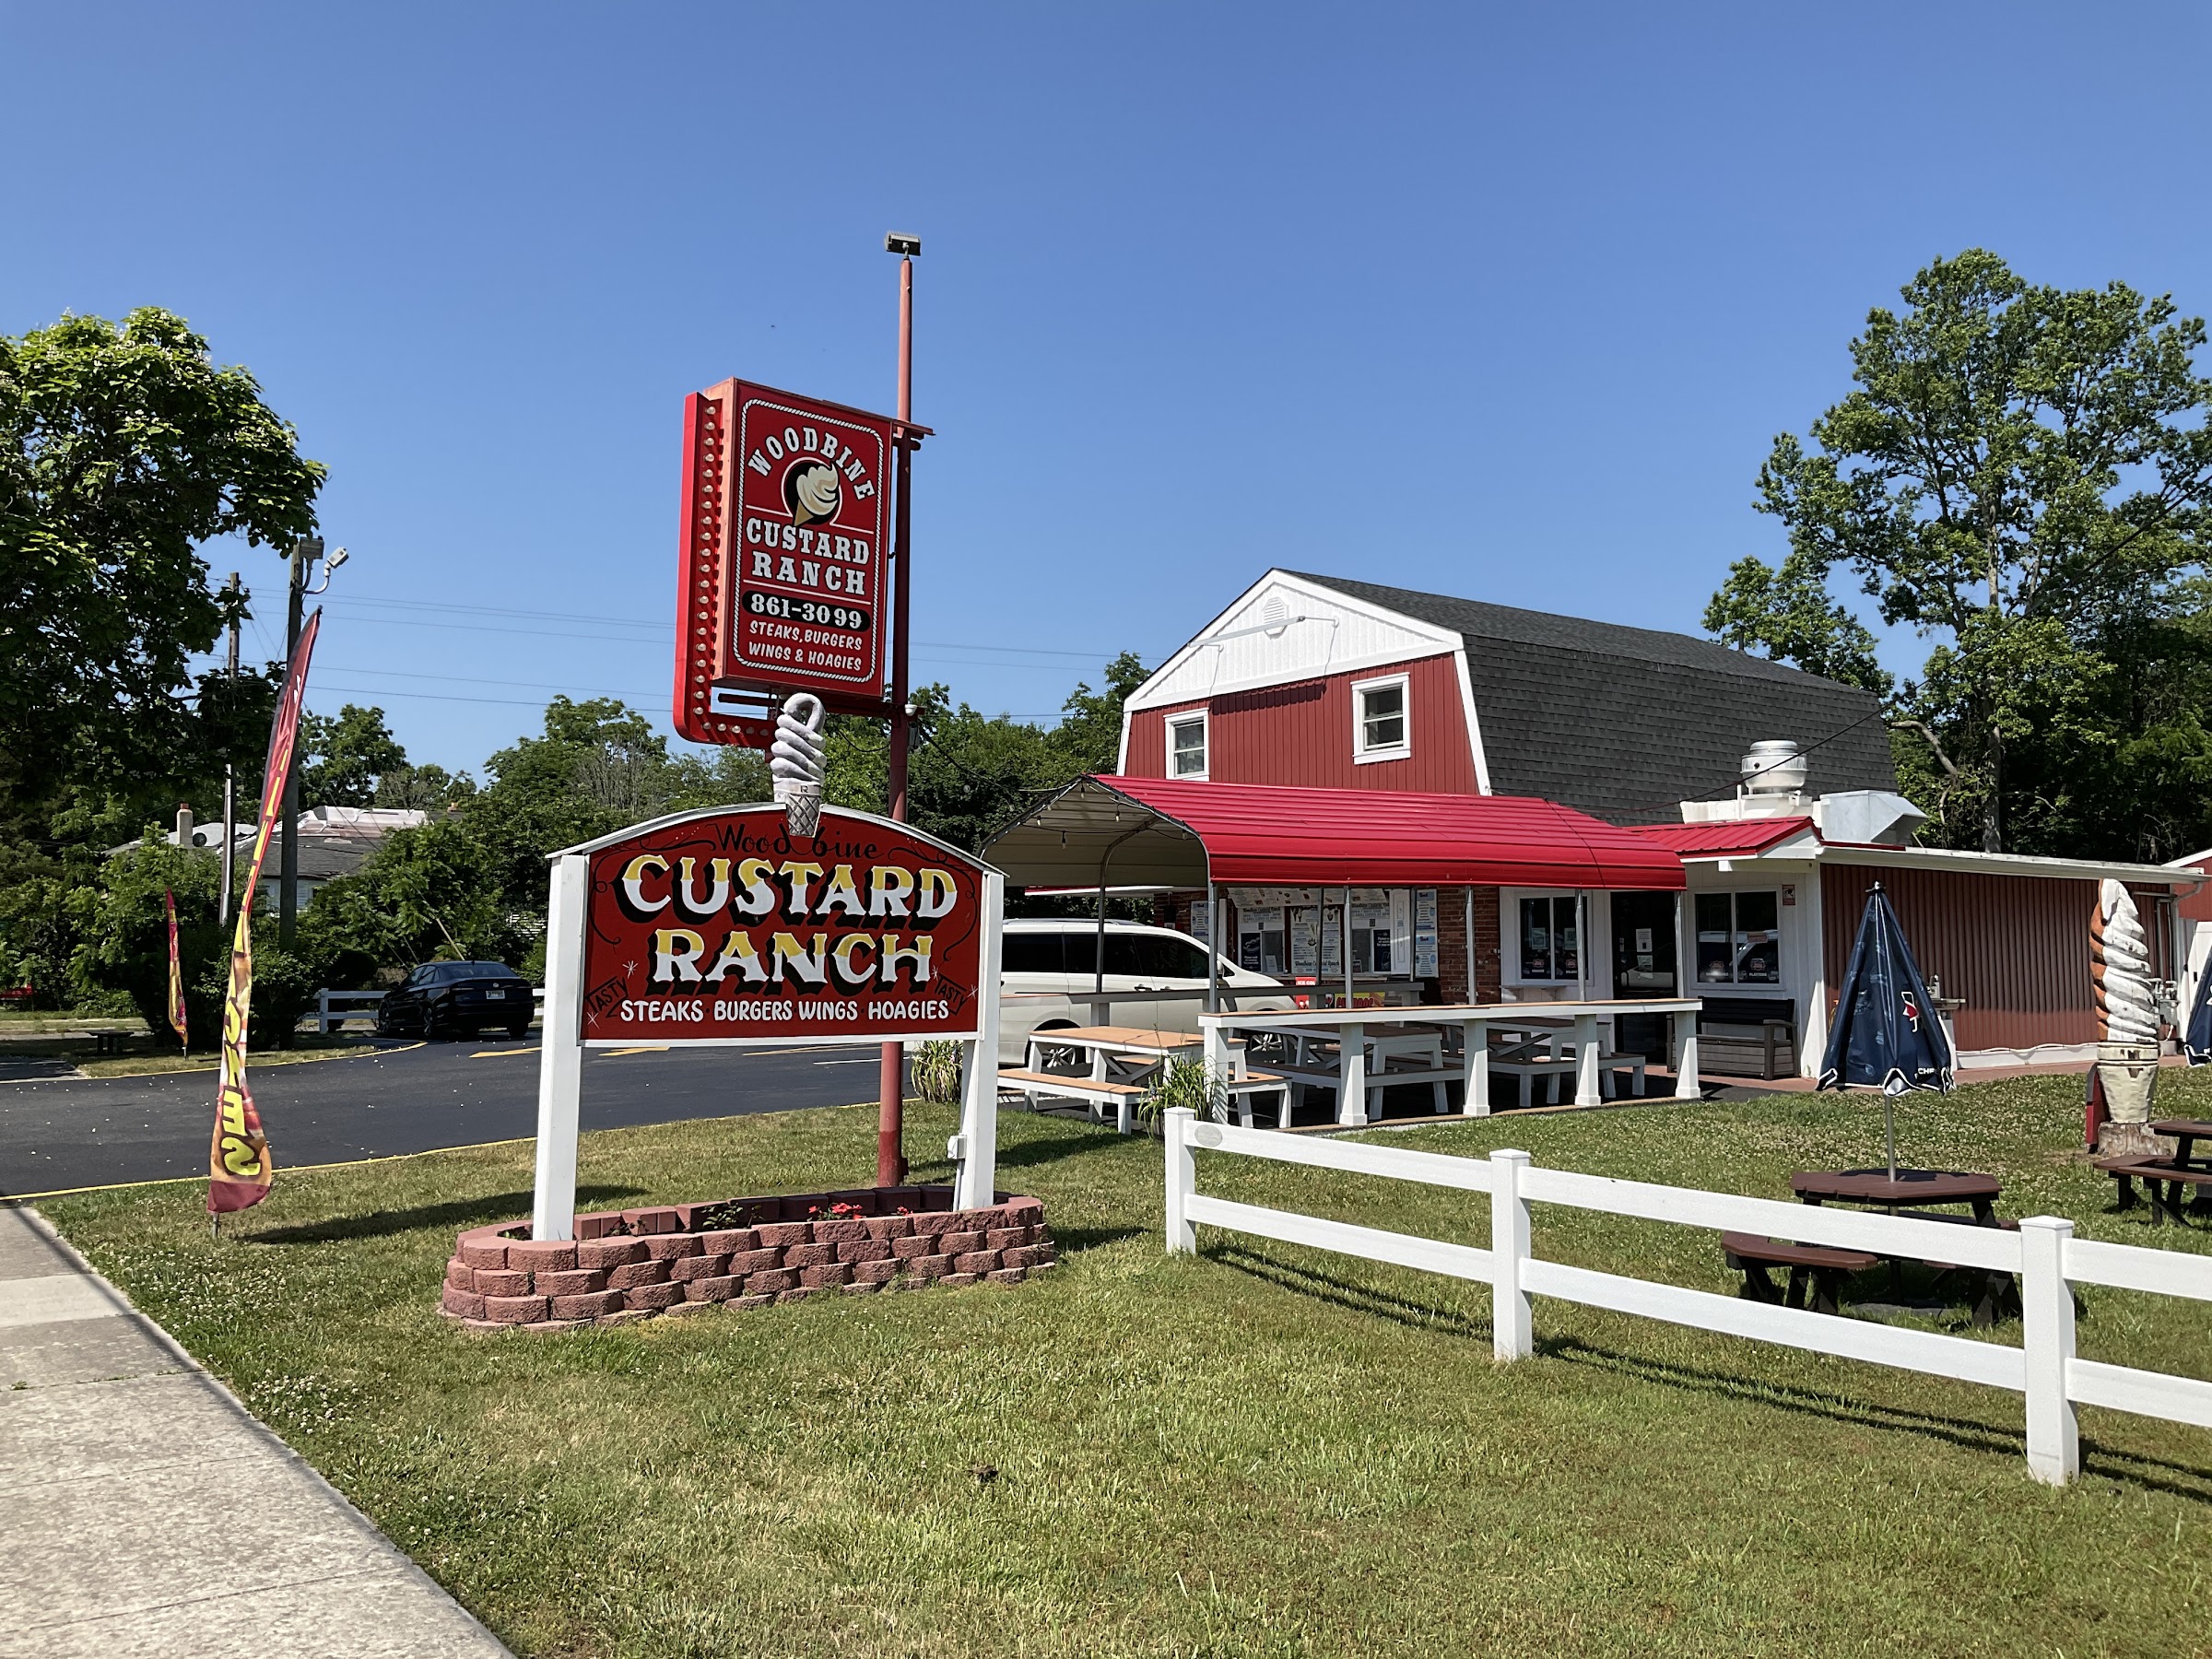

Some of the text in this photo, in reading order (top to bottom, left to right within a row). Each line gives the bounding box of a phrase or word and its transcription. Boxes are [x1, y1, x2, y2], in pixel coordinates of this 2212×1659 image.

[747, 426, 875, 501] WOODBINE
[746, 517, 870, 565] CUSTARD
[751, 550, 866, 596] RANCH
[750, 593, 863, 629] 861-3099
[748, 641, 863, 672] WINGS & HOAGIES
[620, 853, 959, 921] CUSTARD
[651, 927, 935, 986] RANCH
[585, 976, 629, 1018] TASTY
[620, 999, 949, 1022] STEAKS BURGERS WINGS HOAGIES
[935, 973, 969, 1016] TASTY
